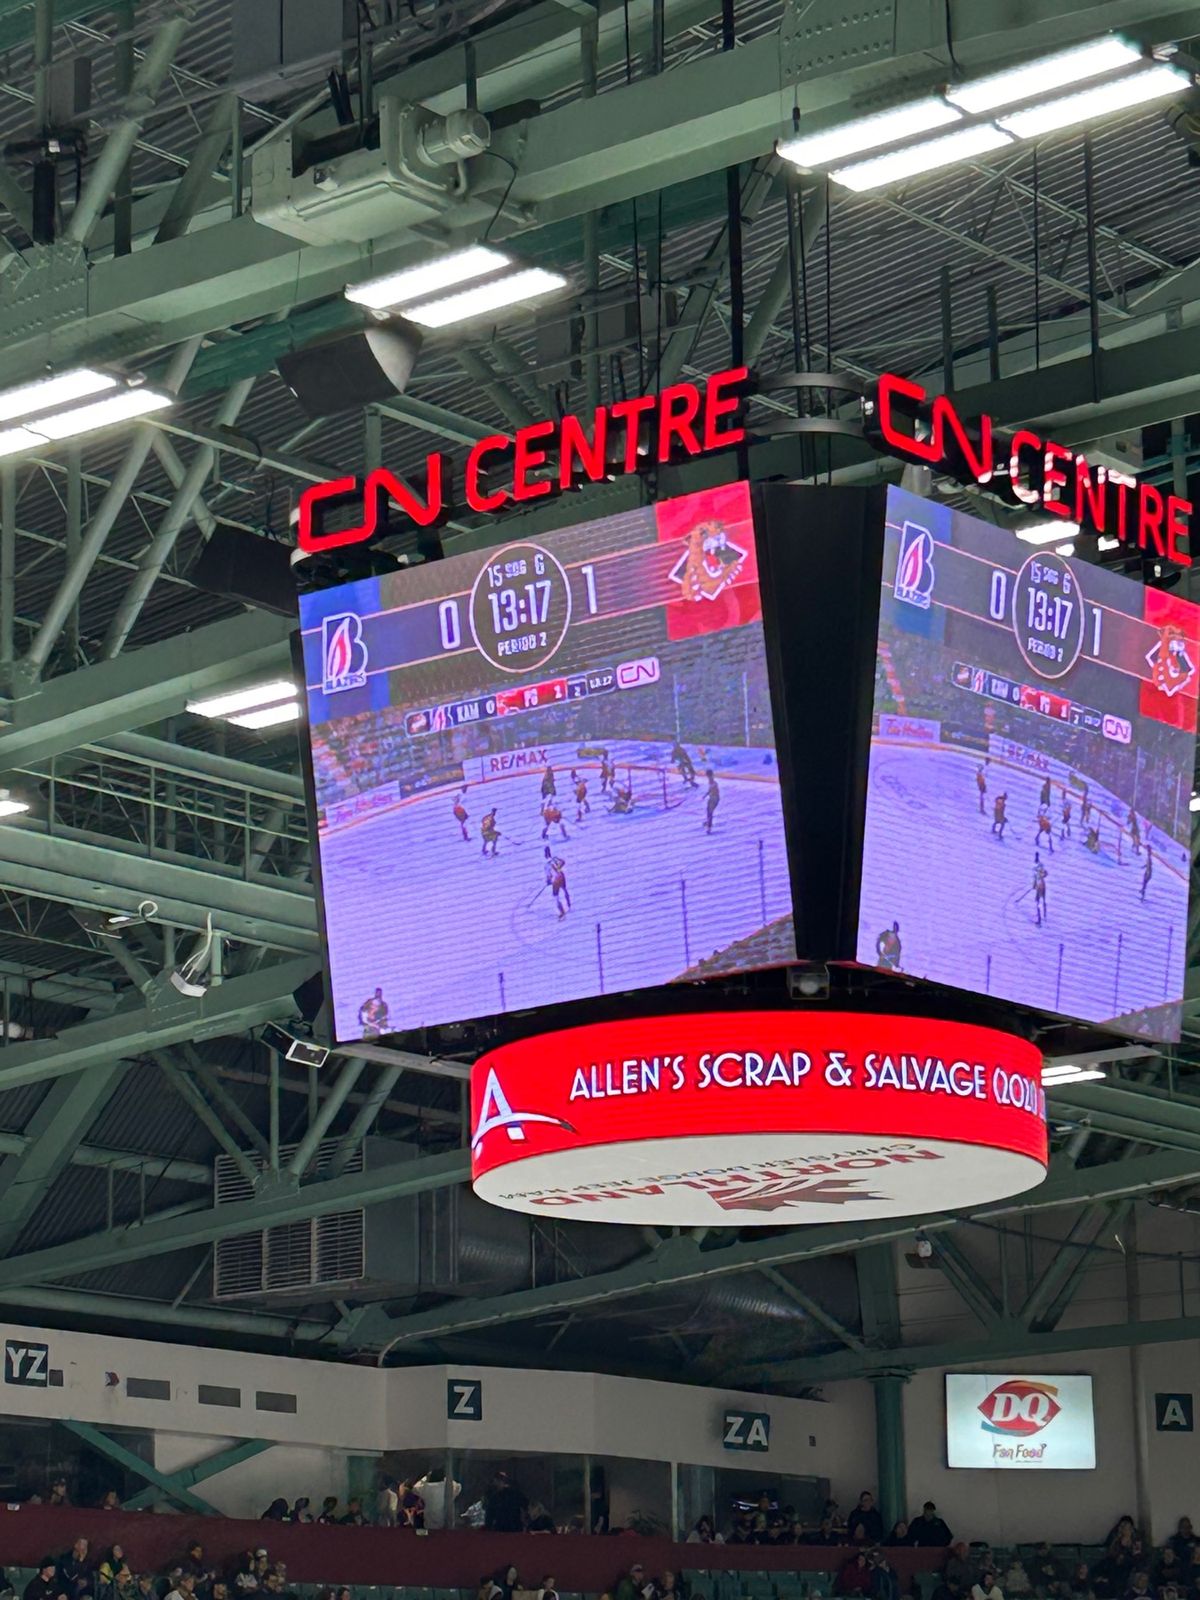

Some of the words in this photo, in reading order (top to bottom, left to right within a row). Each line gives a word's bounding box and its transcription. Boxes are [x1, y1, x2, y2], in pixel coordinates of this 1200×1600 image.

[300, 452, 441, 553] CN
[465, 366, 749, 512] CENTRE
[878, 373, 993, 484] CN
[1009, 430, 1193, 568] CENTRE
[487, 564, 503, 588] 15
[581, 564, 597, 614] 1
[990, 570, 1007, 620] 0
[438, 599, 461, 650] 0
[487, 580, 551, 634] 13:17
[1028, 587, 1073, 640] 13:17
[1092, 607, 1102, 656] 1
[497, 634, 537, 656] PERIOD
[539, 632, 547, 647] 2
[1027, 637, 1056, 660] PERIOD
[457, 702, 479, 722] KAM
[620, 666, 655, 684] CN
[490, 749, 548, 772] RE/MAX
[570, 1055, 685, 1101] ALLEN'S
[698, 1052, 811, 1089] SCRAP
[825, 1053, 852, 1087] &
[864, 1054, 987, 1099] SALVAGE
[529, 1150, 945, 1206] NORTHLAND
[6, 1346, 47, 1380] YZ
[453, 1385, 475, 1414] Z
[991, 1392, 1050, 1427] DQ
[1162, 1399, 1188, 1426] A
[723, 1415, 769, 1446] ZA
[1016, 1443, 1047, 1458] Food
